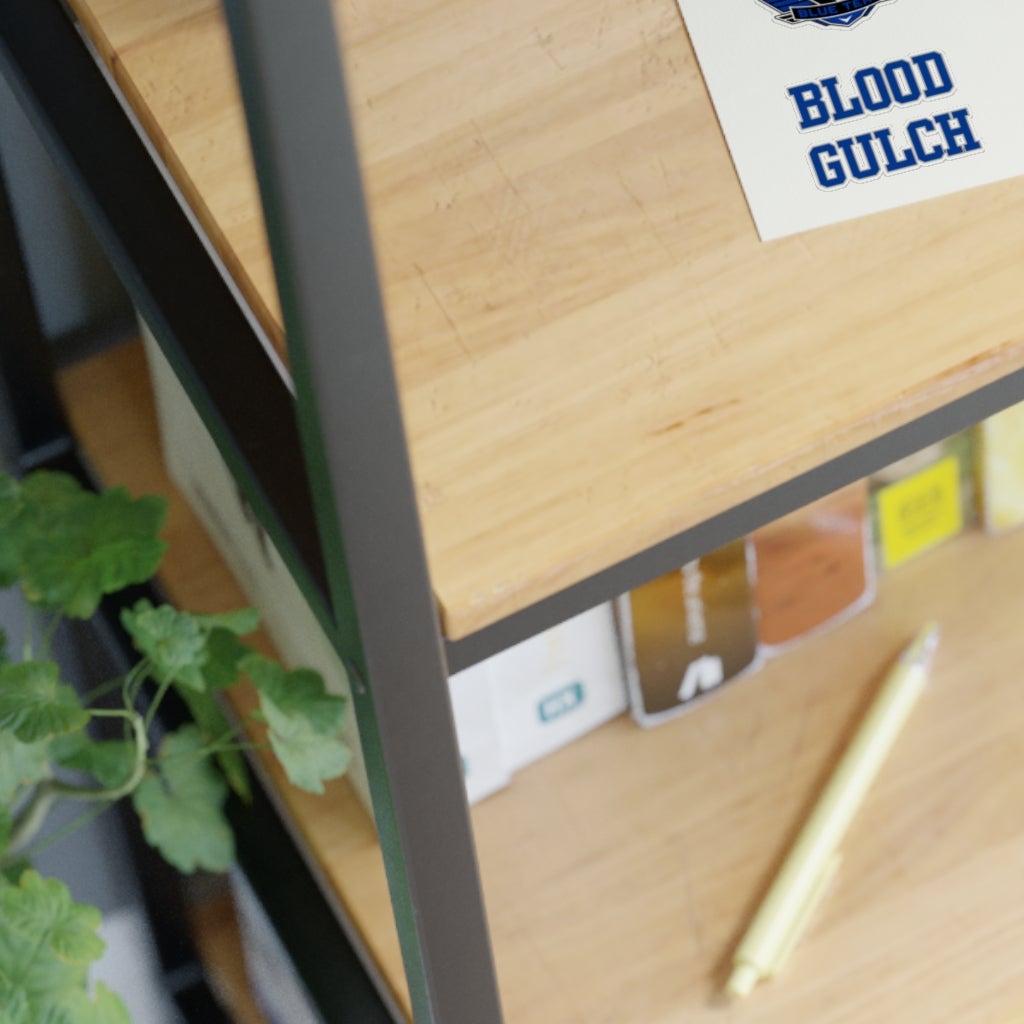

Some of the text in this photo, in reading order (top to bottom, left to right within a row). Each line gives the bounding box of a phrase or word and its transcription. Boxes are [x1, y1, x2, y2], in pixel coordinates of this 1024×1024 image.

[797, 4, 839, 18] BLUE
[787, 50, 954, 130] BLOOD
[809, 107, 983, 188] GULCH
